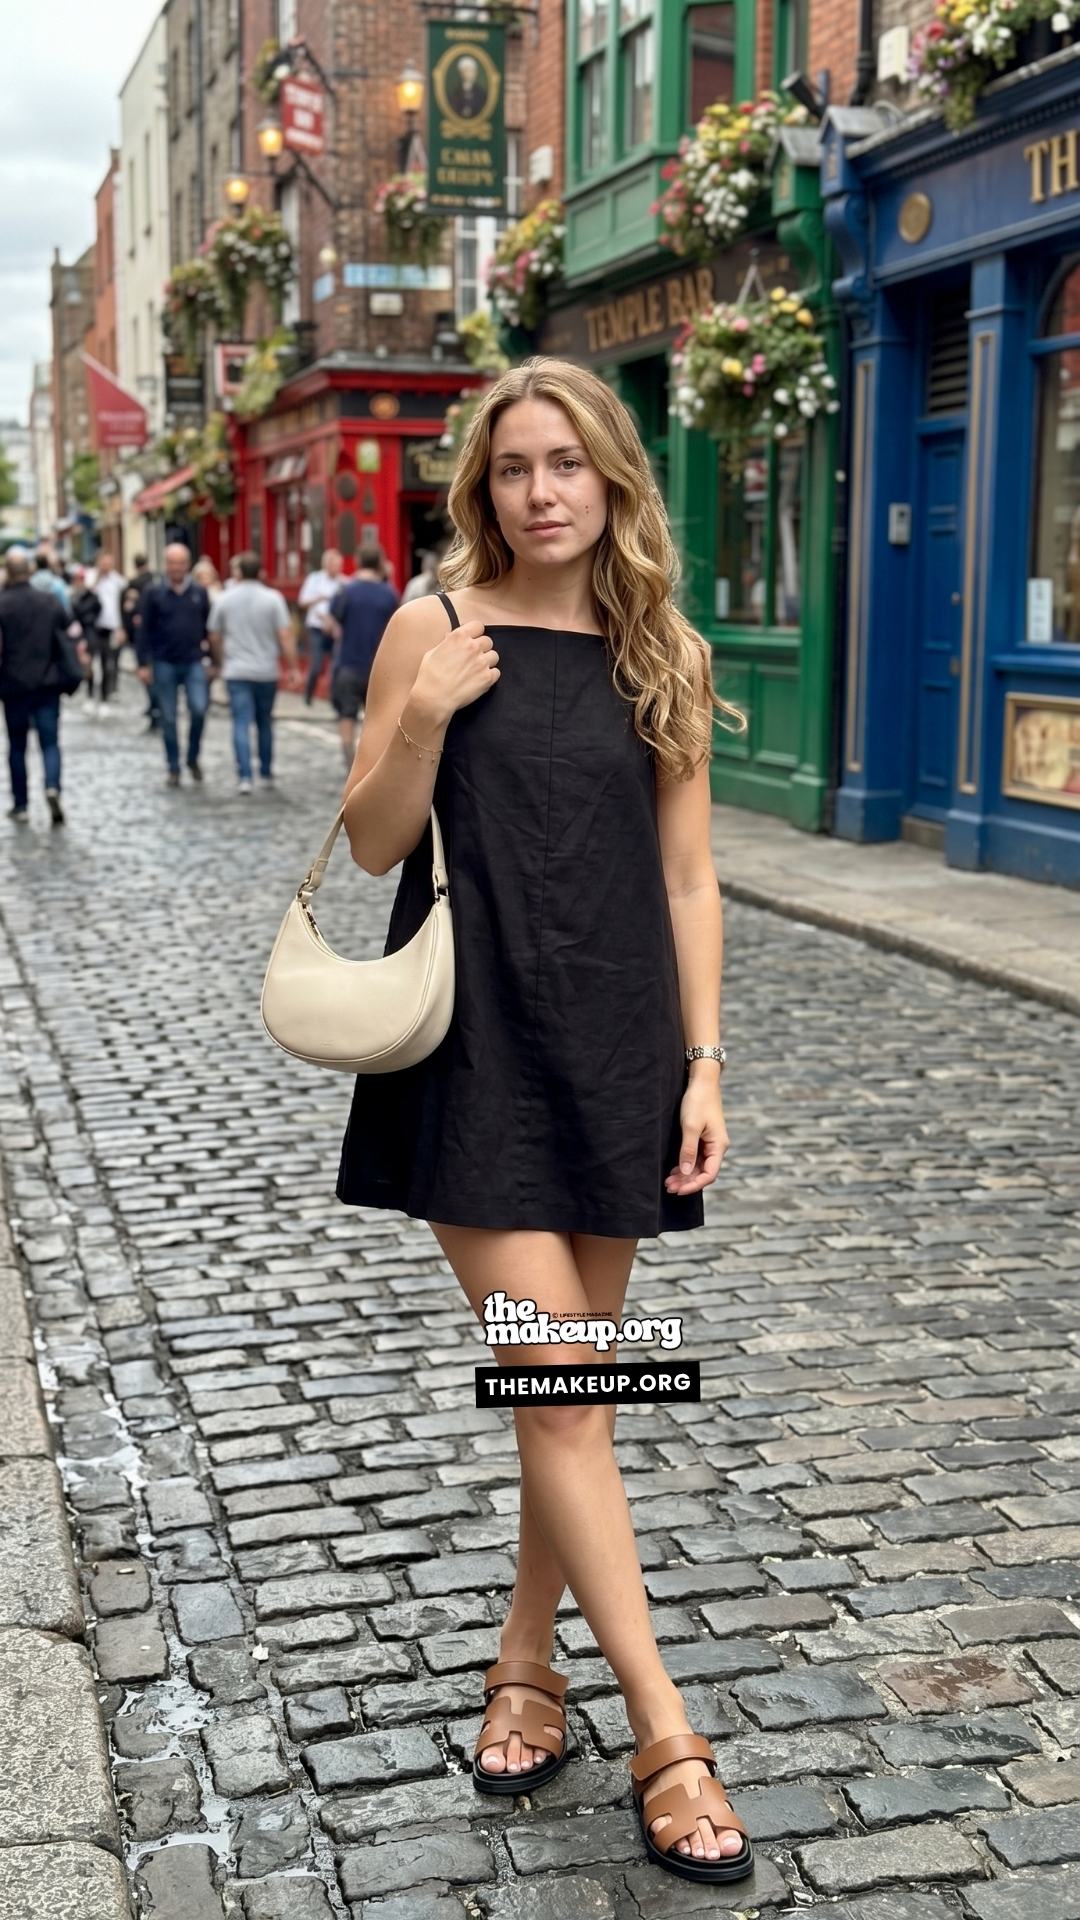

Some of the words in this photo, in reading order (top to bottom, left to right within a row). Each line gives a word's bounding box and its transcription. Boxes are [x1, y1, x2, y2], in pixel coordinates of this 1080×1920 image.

[1023, 130, 1080, 203] TH
[584, 285, 664, 352] TEMPLE
[667, 267, 714, 327] BAR
